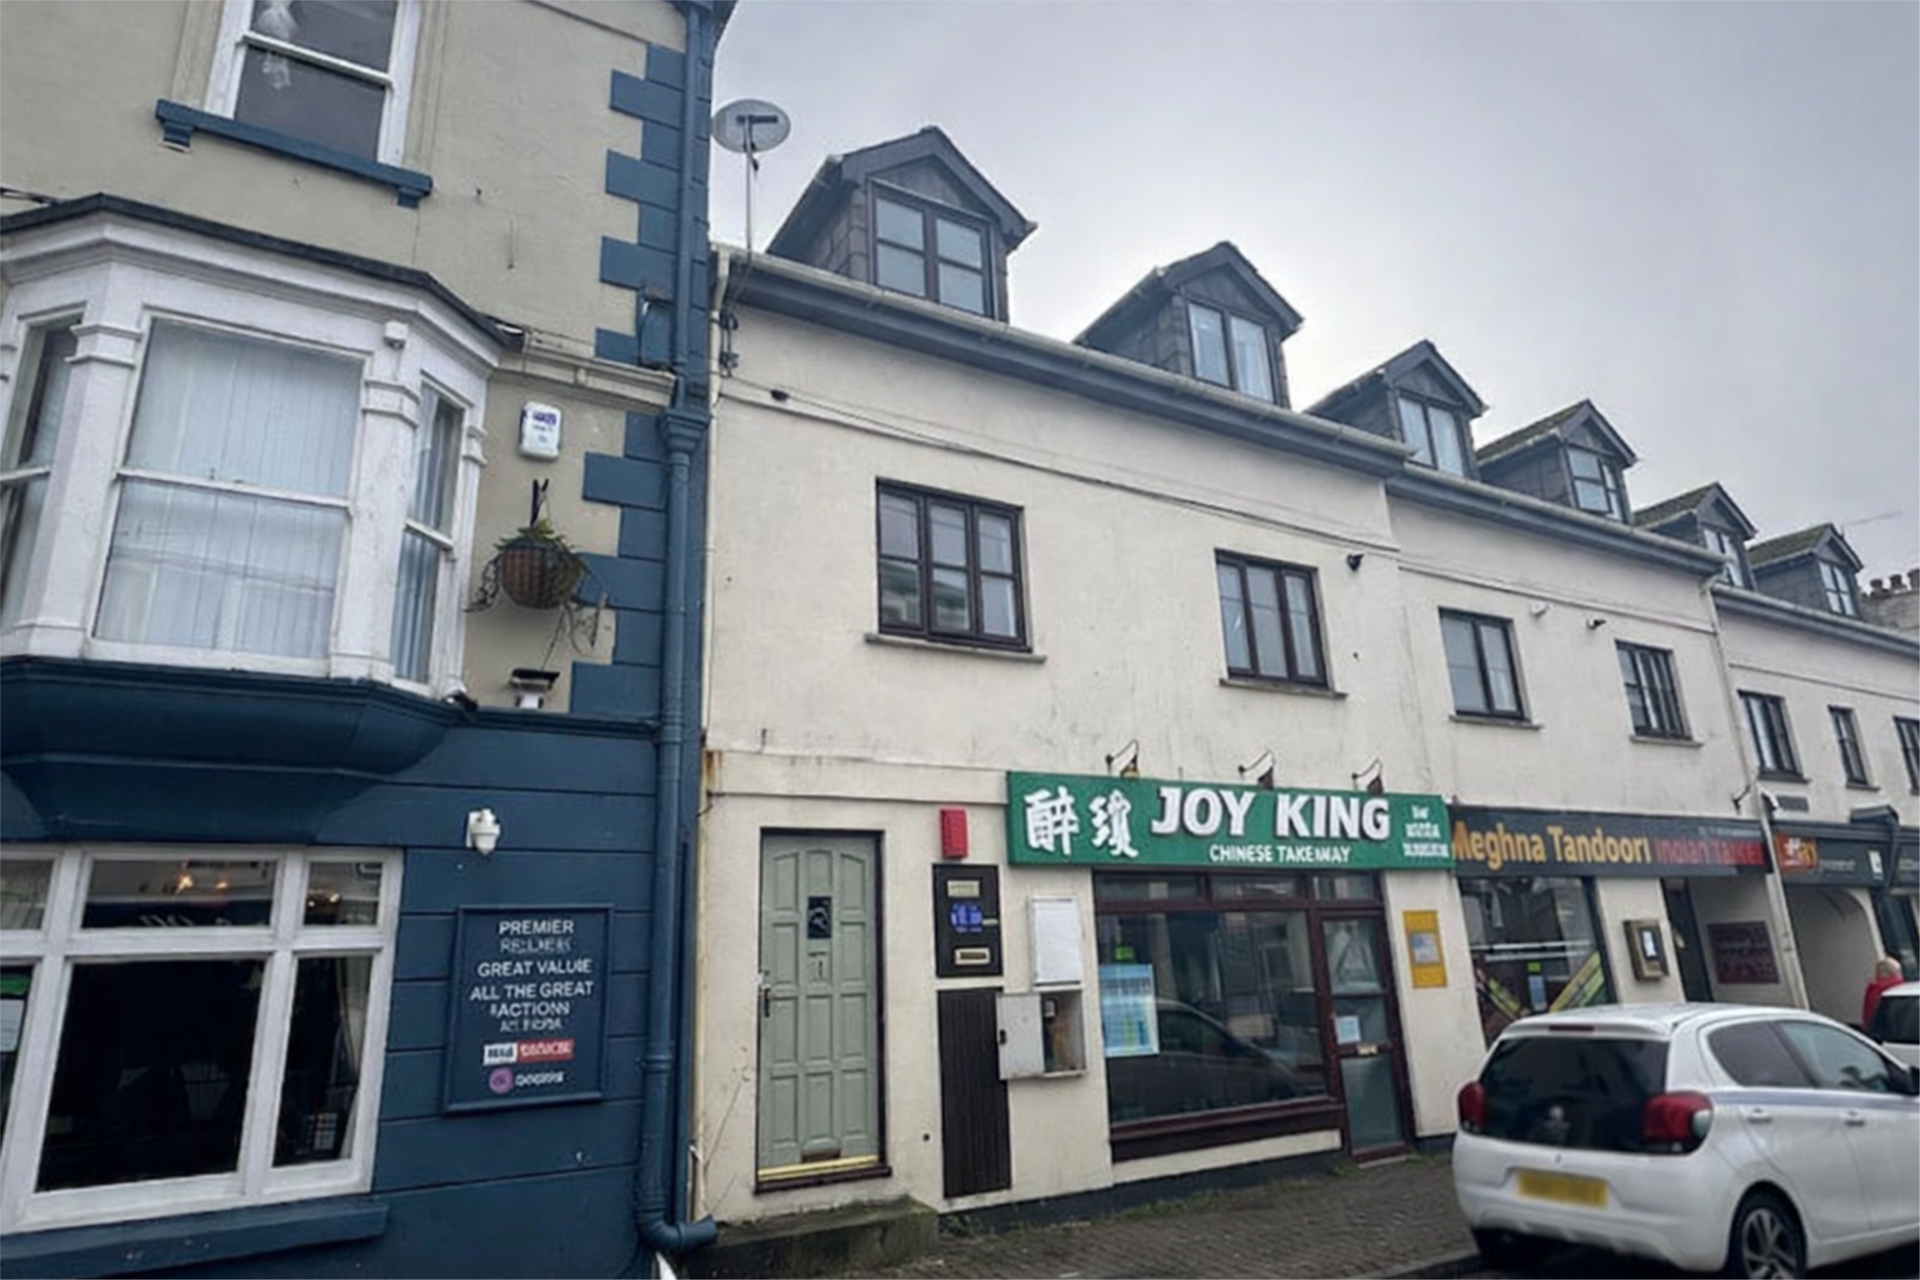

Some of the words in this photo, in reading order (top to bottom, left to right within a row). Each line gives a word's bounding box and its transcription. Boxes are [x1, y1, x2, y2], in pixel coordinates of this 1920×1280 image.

[1151, 787, 1256, 837] JOY
[1276, 794, 1390, 840] KING
[1209, 844, 1274, 862] CHINESE
[1452, 820, 1546, 871] Meghna
[1547, 825, 1651, 864] Tandoori
[499, 920, 574, 935] PREMIER
[477, 961, 533, 977] GREAT
[470, 986, 499, 1000] ALL
[504, 984, 536, 998] THE
[539, 981, 594, 997] GREAT
